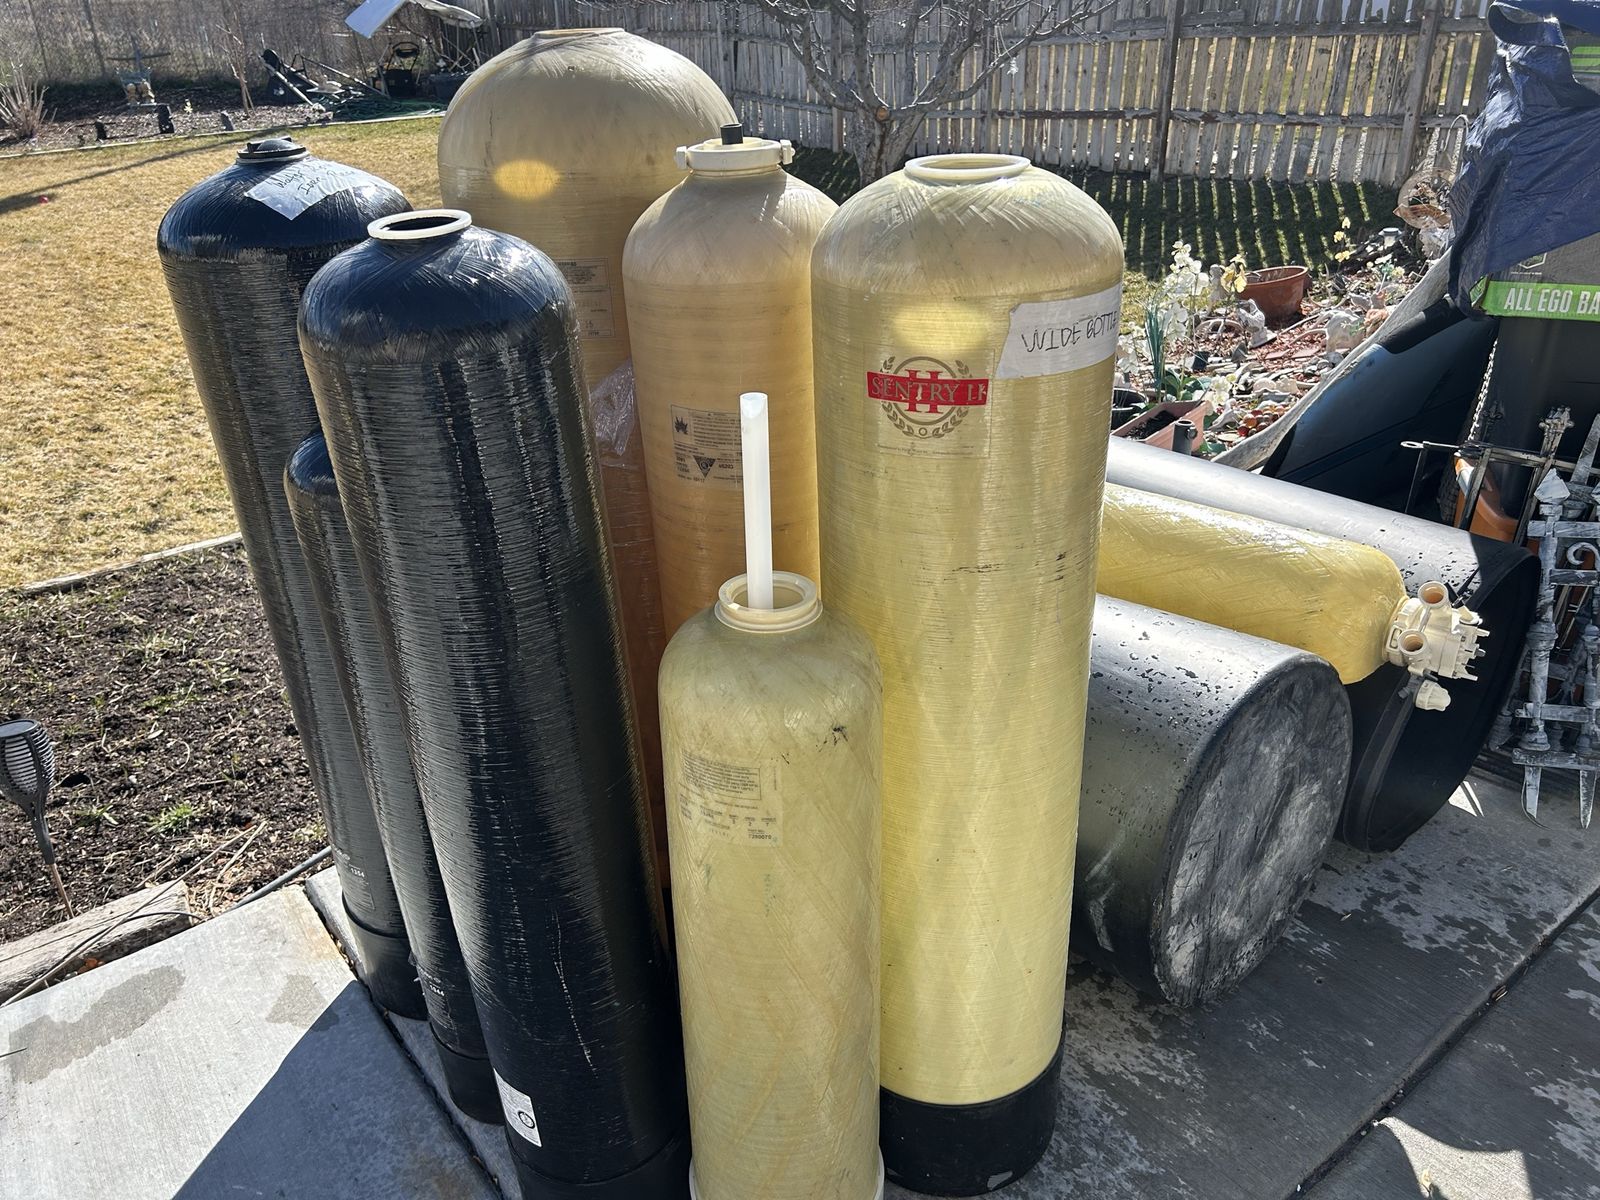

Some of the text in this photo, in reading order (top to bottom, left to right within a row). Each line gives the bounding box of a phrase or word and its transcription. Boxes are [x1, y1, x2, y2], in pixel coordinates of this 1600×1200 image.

[1503, 287, 1533, 311] ALL
[1537, 288, 1573, 313] EGO
[1021, 325, 1081, 352] WIDE
[871, 376, 959, 402] SENTRY
